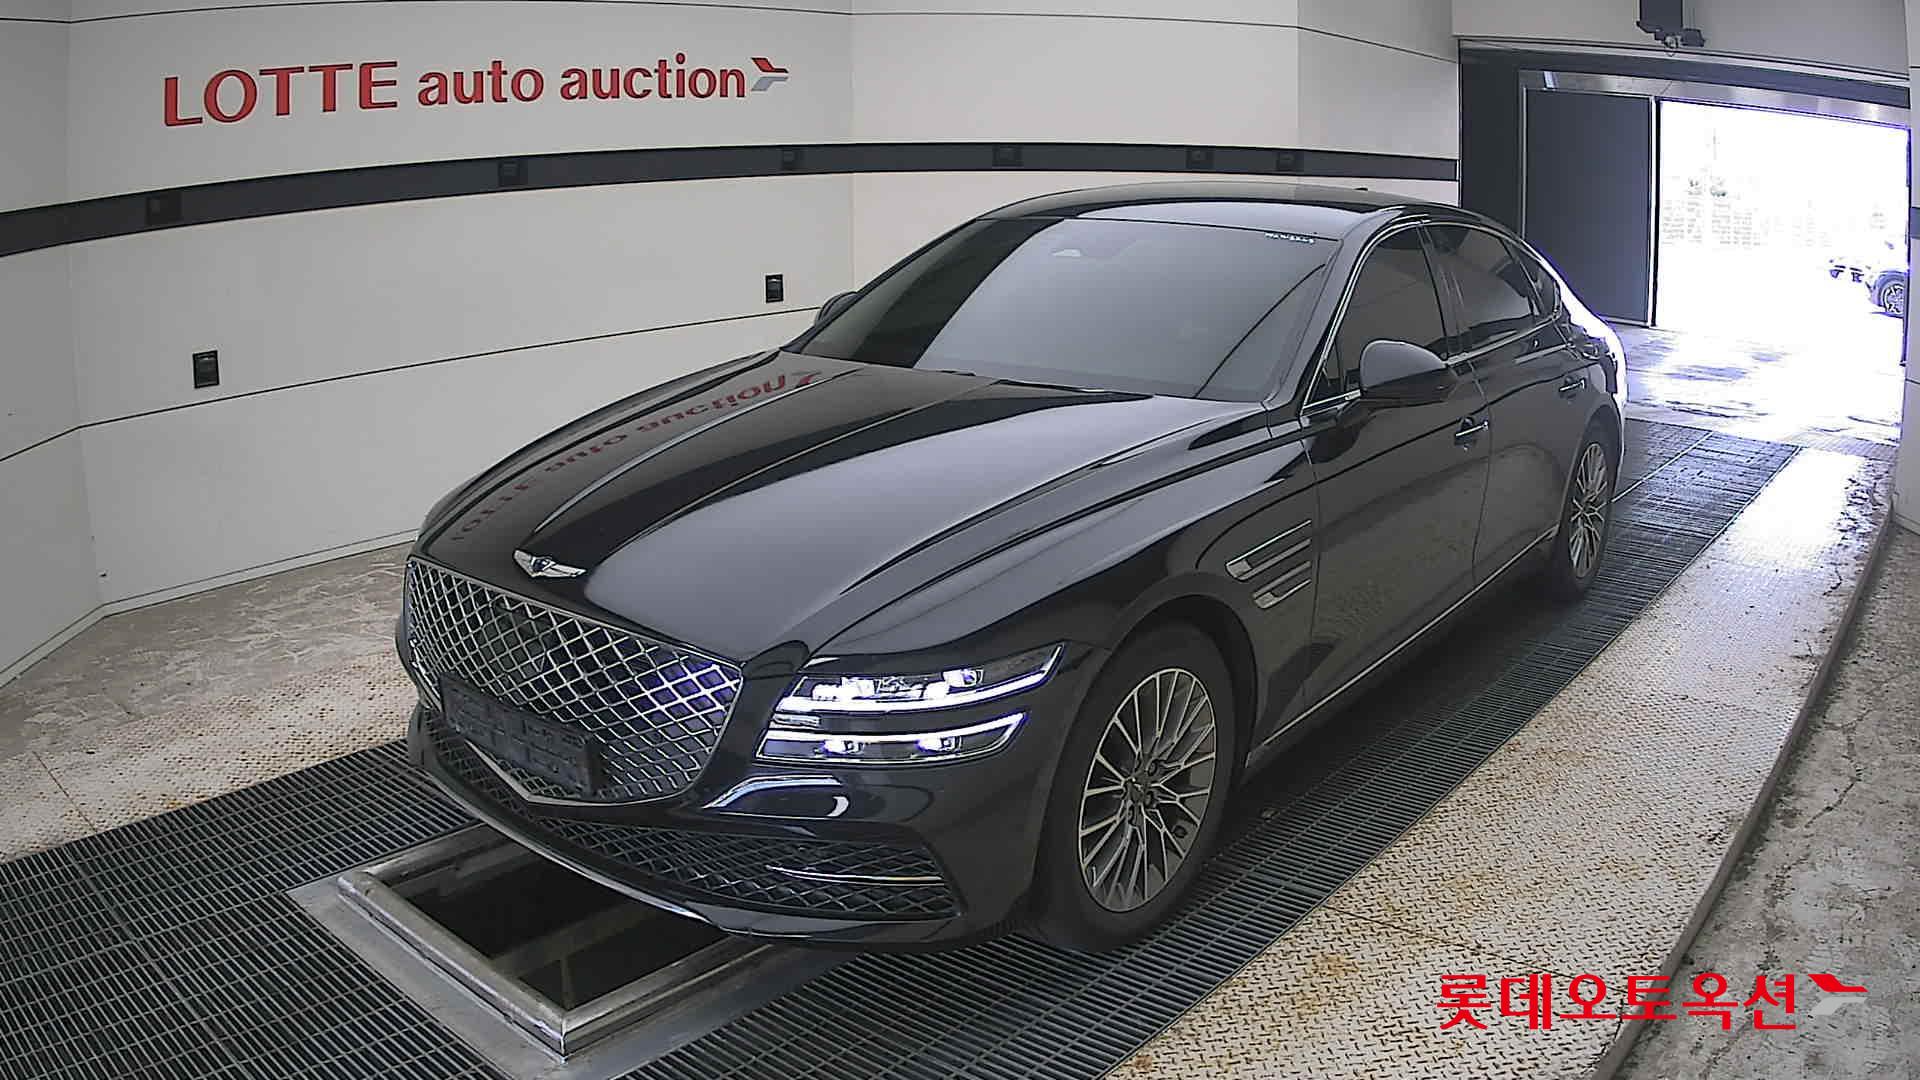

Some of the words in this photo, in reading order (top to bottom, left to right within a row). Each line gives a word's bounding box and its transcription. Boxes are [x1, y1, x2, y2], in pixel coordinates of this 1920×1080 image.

[164, 62, 398, 127] LOTTE
[417, 61, 544, 105] auto
[560, 53, 746, 101] auction
